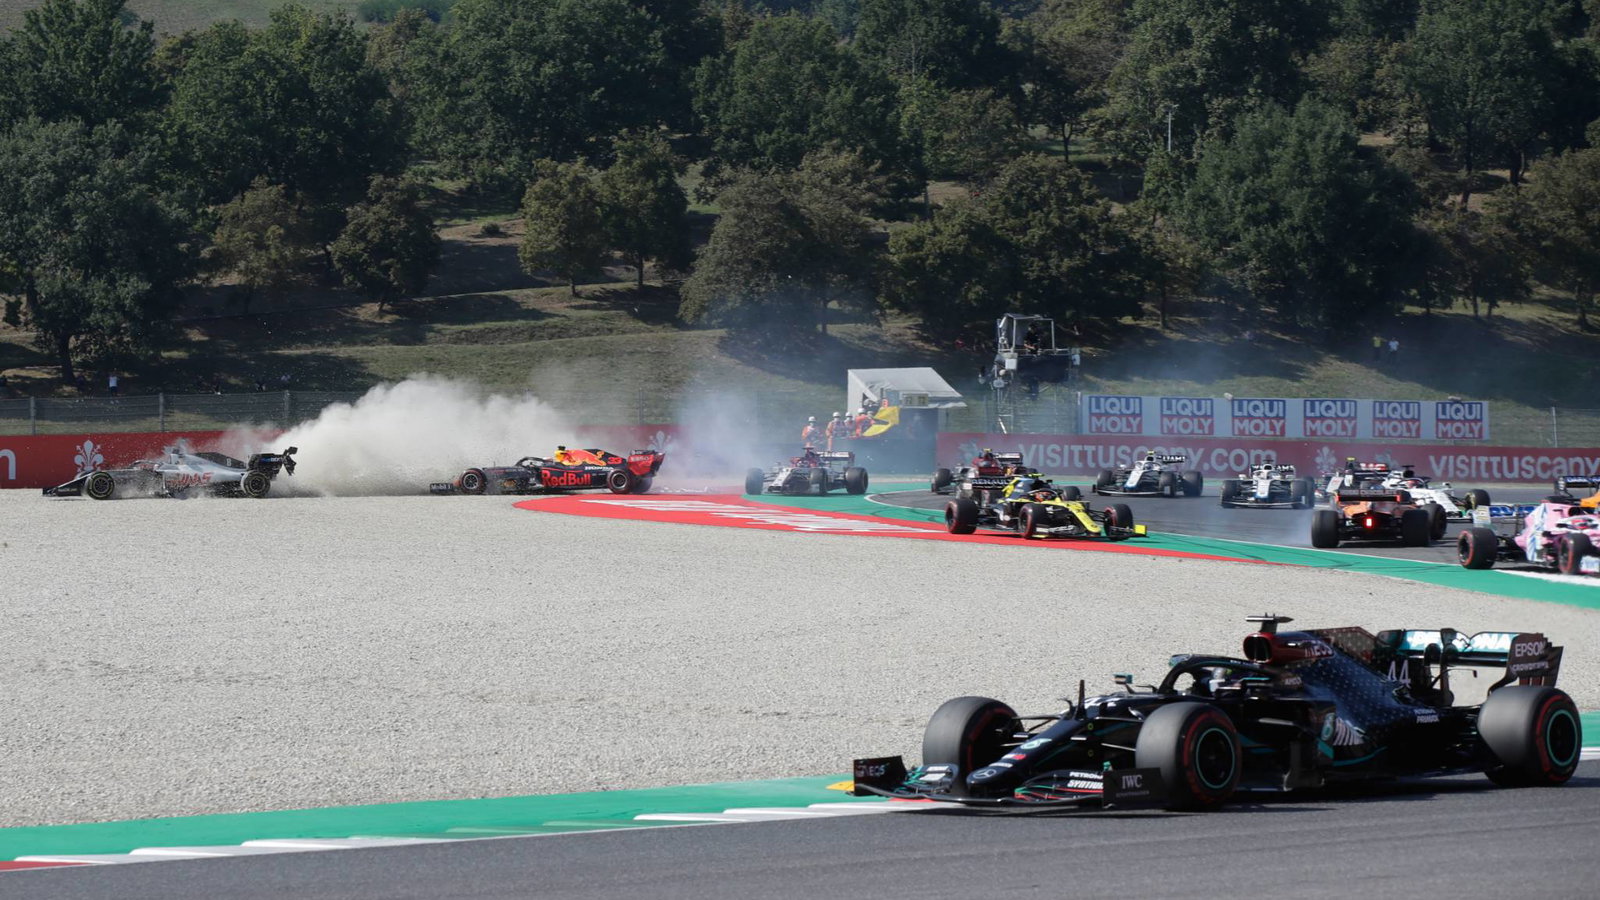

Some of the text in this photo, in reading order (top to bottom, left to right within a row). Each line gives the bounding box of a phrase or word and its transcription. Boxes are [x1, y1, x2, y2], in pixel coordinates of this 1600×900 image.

[1091, 396, 1140, 414] LIQUI
[1163, 398, 1212, 416] LIQUI
[1233, 400, 1284, 417] LIQUI
[1305, 400, 1355, 418] LIQUI
[1375, 402, 1419, 419] LIQUI
[1438, 403, 1481, 421] LIQUI
[1091, 416, 1141, 433] MOLY
[1163, 417, 1212, 434] MOLY
[1234, 419, 1285, 436] MOLY
[1305, 419, 1356, 437] MOLY
[1374, 420, 1420, 438] MOLY
[1438, 422, 1482, 438] MOLY
[1515, 641, 1546, 657] EPSON
[1122, 774, 1142, 789] IWC
